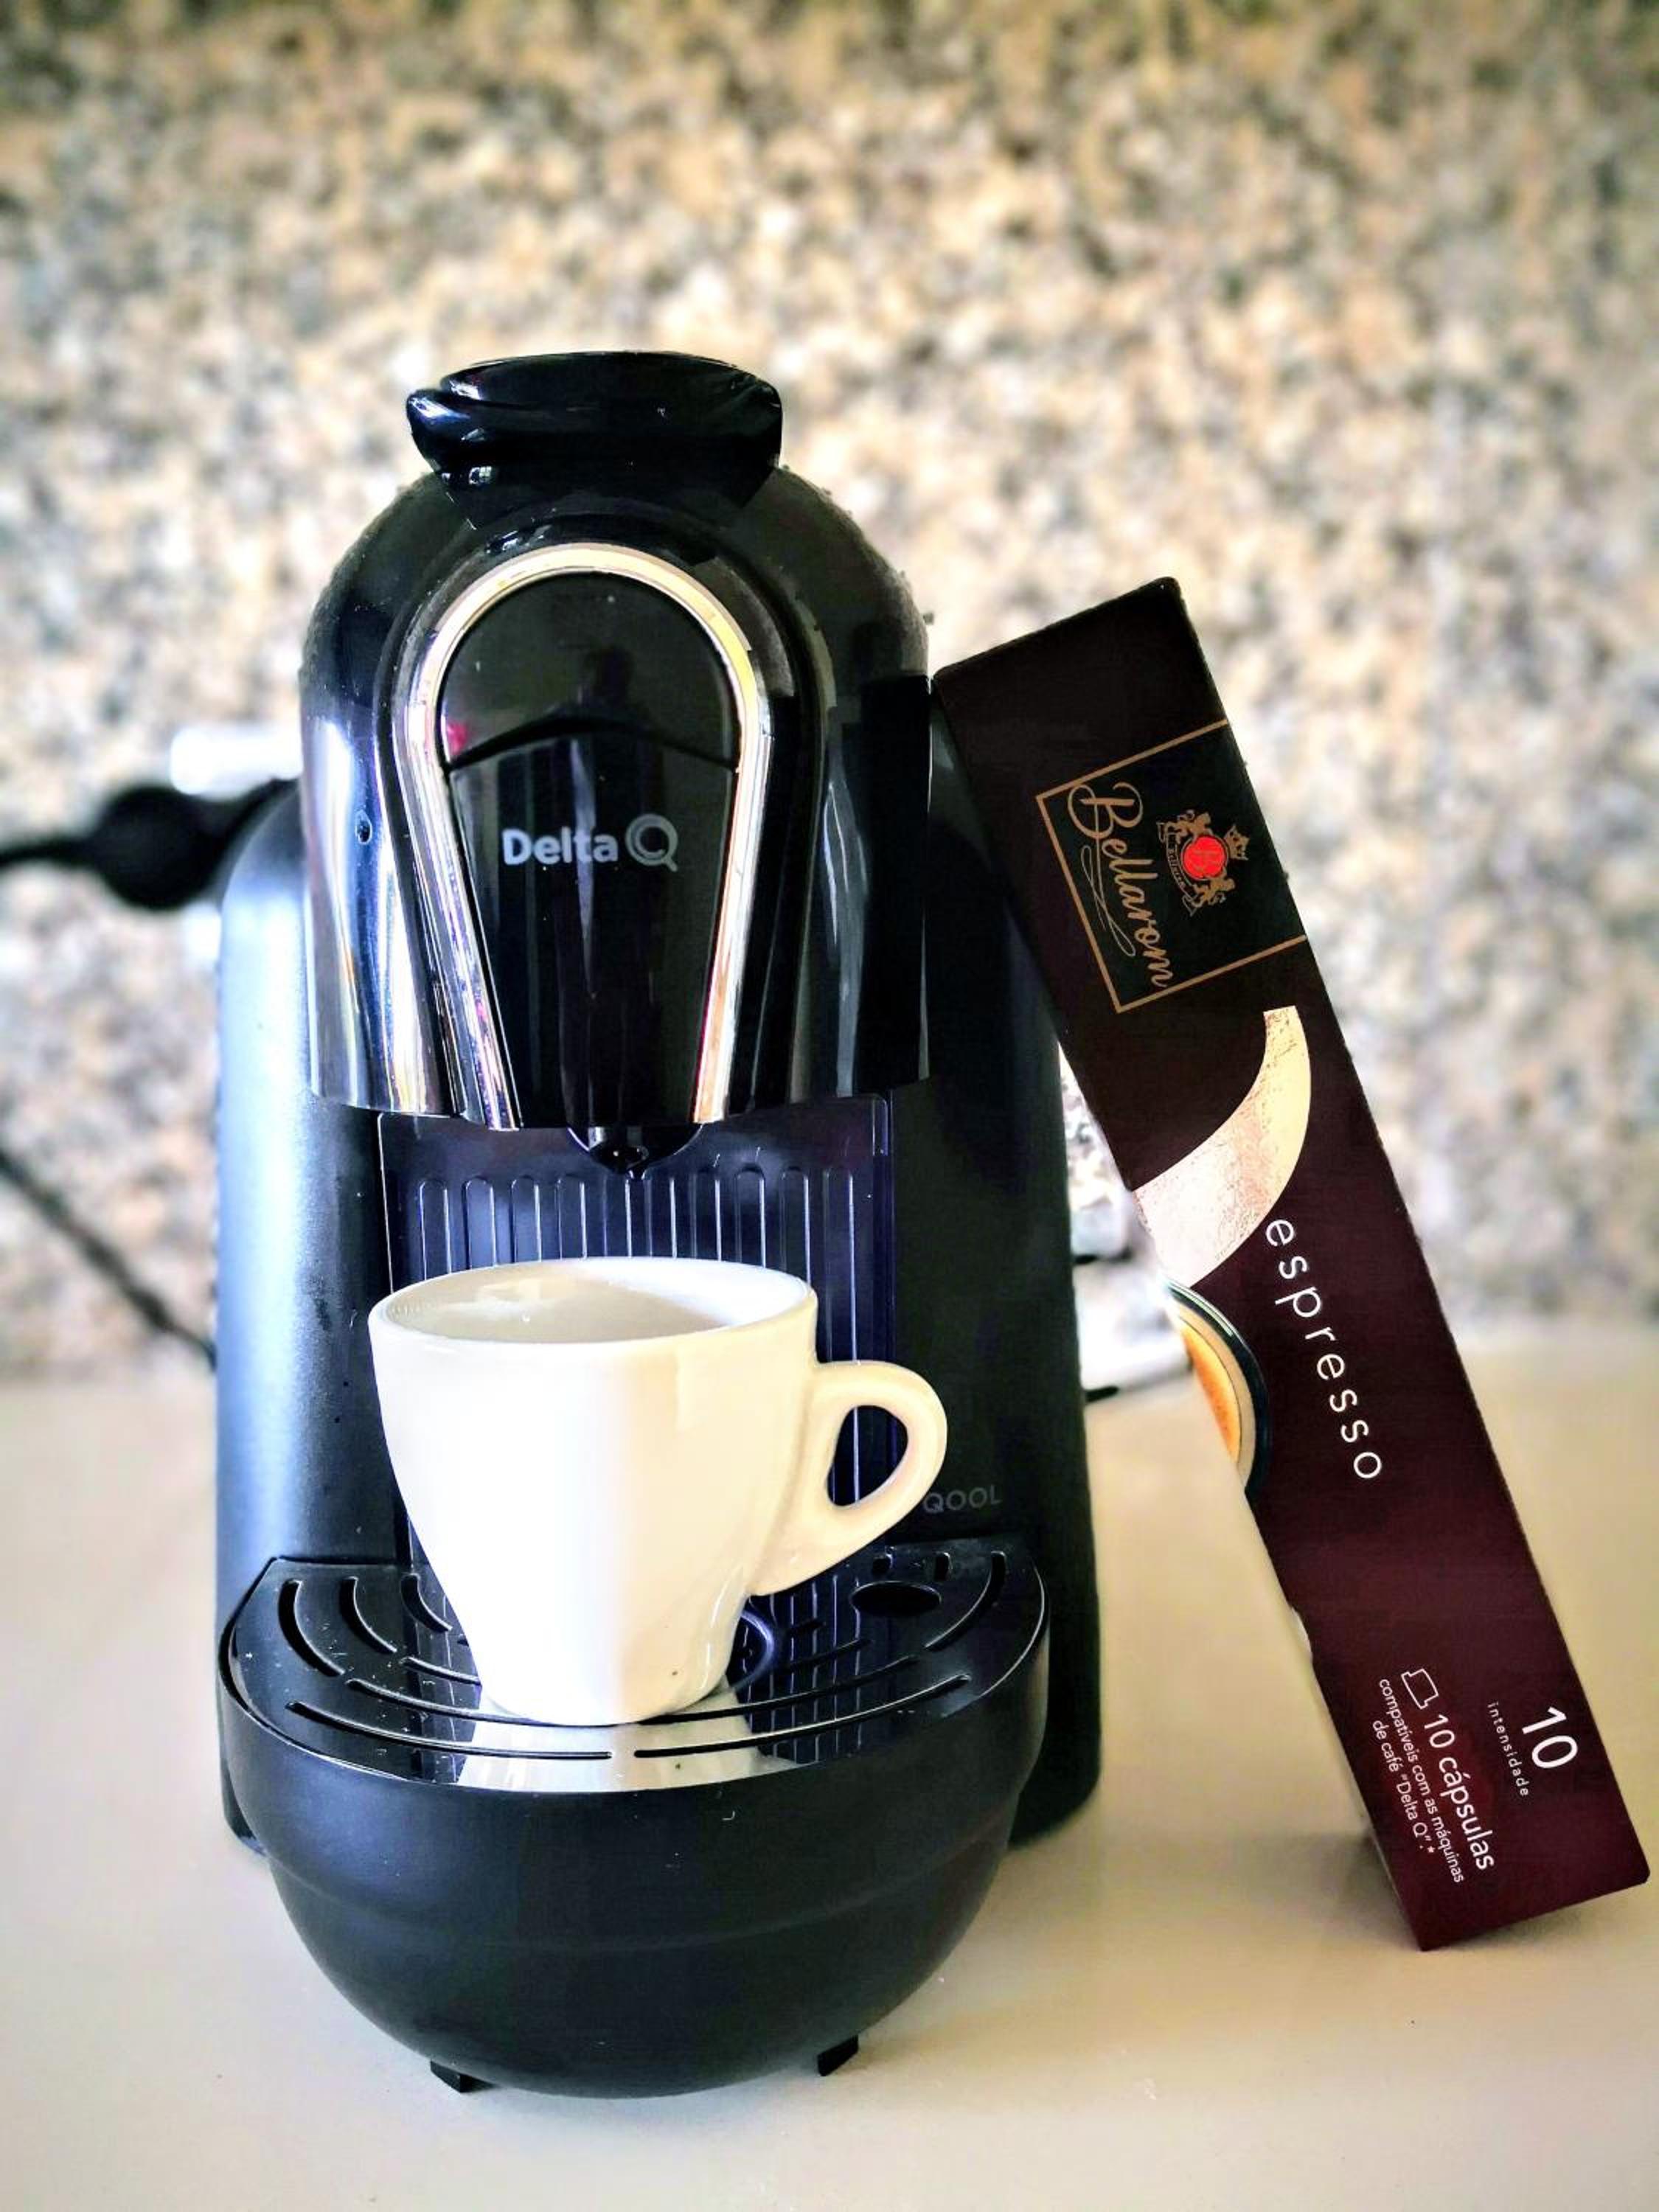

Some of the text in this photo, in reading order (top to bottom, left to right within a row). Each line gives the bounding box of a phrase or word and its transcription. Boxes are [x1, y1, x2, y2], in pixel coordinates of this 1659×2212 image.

[501, 813, 678, 872] Delta Q
[1068, 782, 1172, 988] Bellarom
[1266, 1219, 1382, 1478] espresso
[923, 1484, 1003, 1513] QOOL
[1373, 1720, 1387, 1741] de
[1381, 1742, 1402, 1773] café
[1380, 1678, 1464, 1883] compatíveis com as máquinas
[1487, 1701, 1529, 1796] intensidade
[1522, 1706, 1579, 1769] 10
[1425, 1714, 1495, 1870] 10 cápsulas
